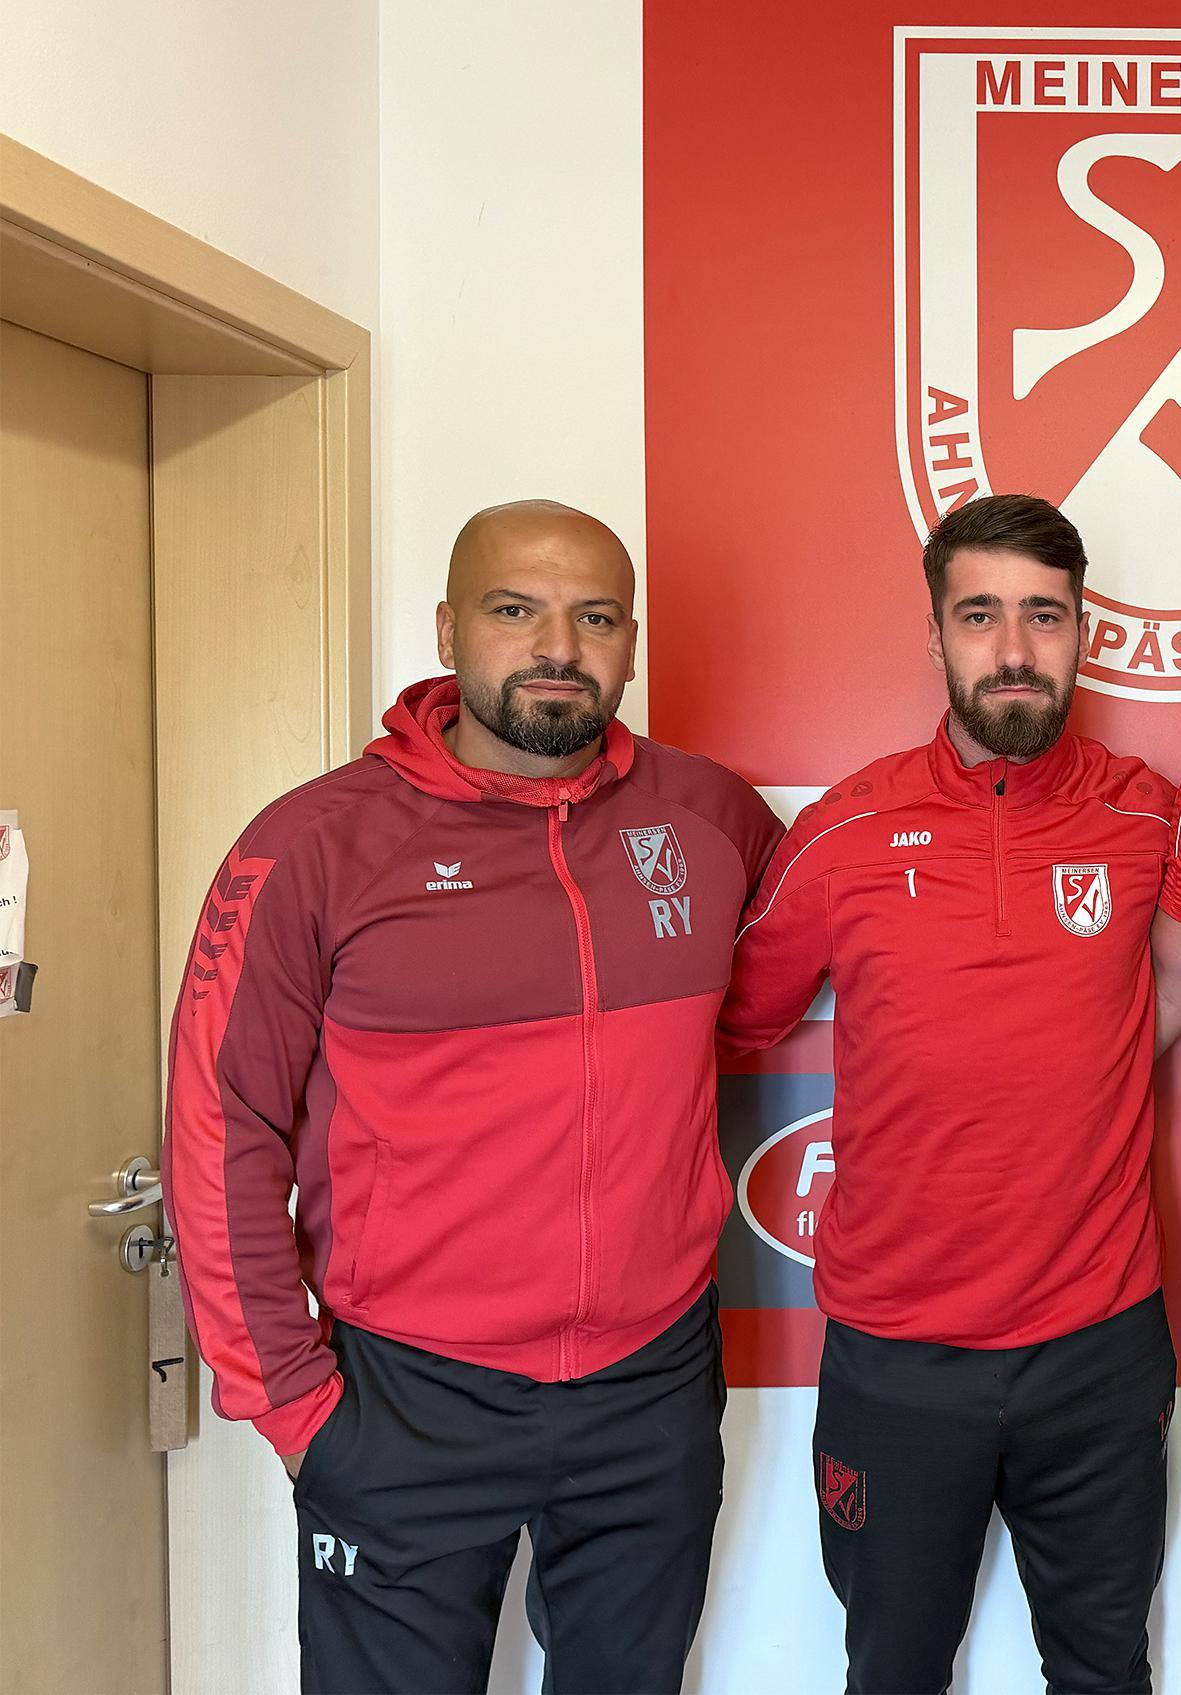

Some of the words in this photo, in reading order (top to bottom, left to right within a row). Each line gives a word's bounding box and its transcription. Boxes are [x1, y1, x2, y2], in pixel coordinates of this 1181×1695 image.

[890, 831, 932, 848] JAKO
[426, 879, 473, 891] erima
[904, 868, 917, 898] 1
[648, 896, 692, 938] RY
[797, 1210, 818, 1237] fl
[312, 1533, 359, 1576] RY
